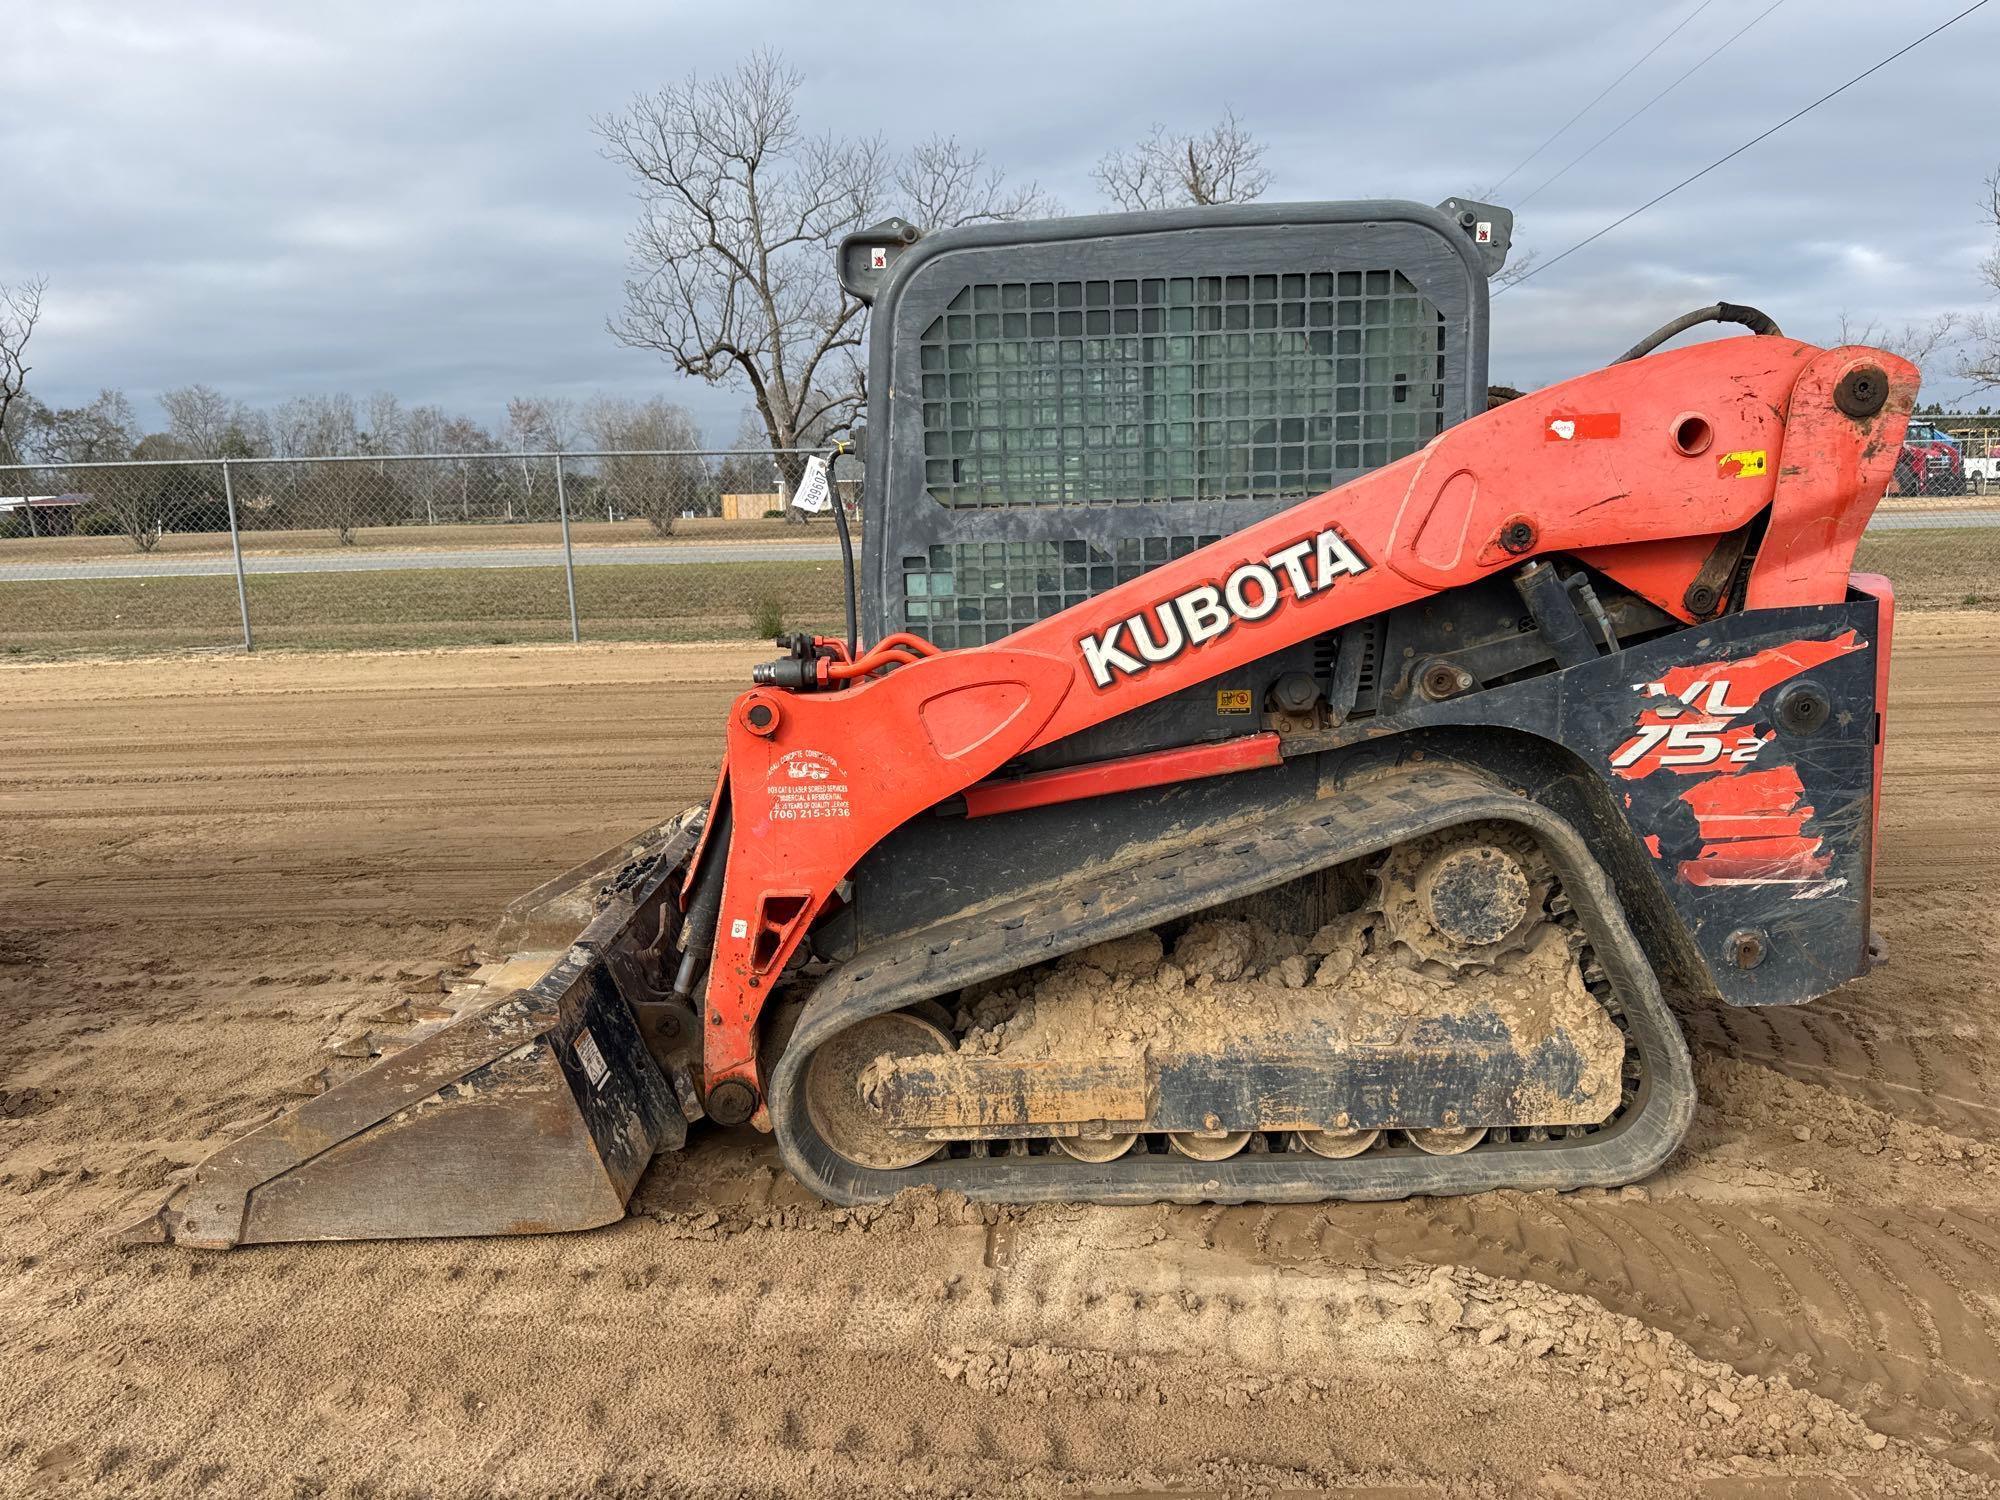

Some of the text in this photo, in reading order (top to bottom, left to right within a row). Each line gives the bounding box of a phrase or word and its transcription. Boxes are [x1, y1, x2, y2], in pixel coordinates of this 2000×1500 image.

[804, 471, 826, 505] 209662
[1079, 529, 1367, 688] KUBOTA
[1632, 681, 1752, 718] VL
[1611, 722, 1768, 768] 75-2
[769, 808, 851, 821] (706) 215-3736
